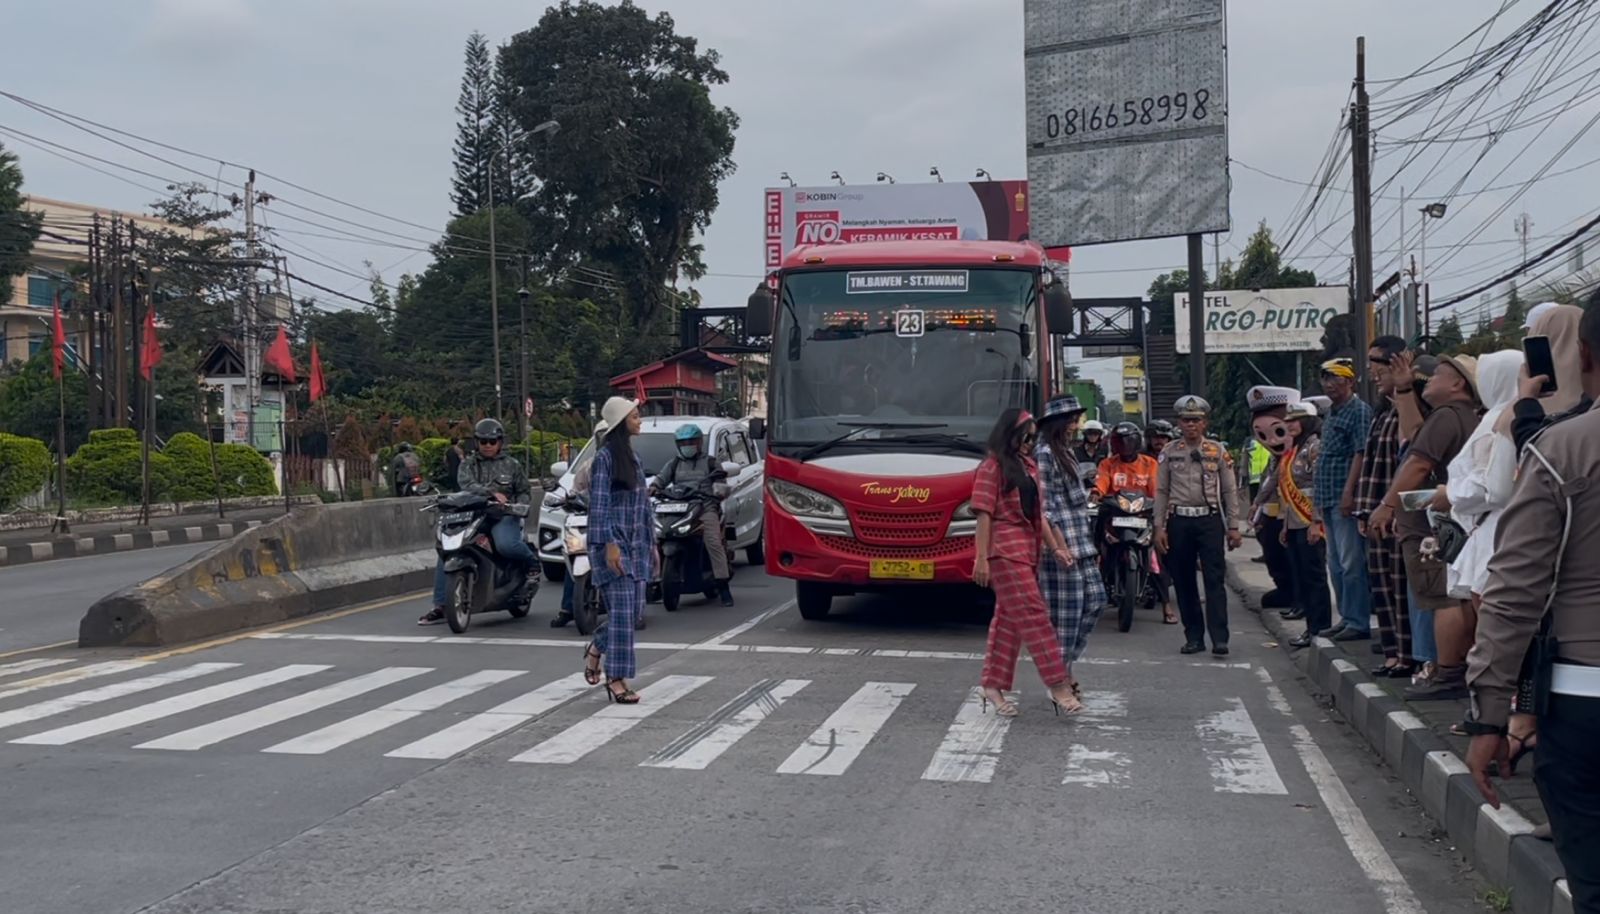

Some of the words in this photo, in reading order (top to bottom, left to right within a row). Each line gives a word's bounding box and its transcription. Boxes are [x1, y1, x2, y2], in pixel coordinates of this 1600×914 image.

[1046, 89, 1209, 139] 0816658998
[806, 193, 837, 201] KOBIN
[801, 222, 838, 244] NO
[850, 276, 902, 288] TM.BAWEN
[909, 274, 965, 287] ST.TAWANG
[1182, 296, 1231, 309] HTEL
[900, 314, 920, 333] 23
[1194, 307, 1338, 331] RGO-PUTRO
[859, 481, 891, 496] Trans
[889, 484, 930, 503] Jateng
[885, 561, 910, 573] 7752
